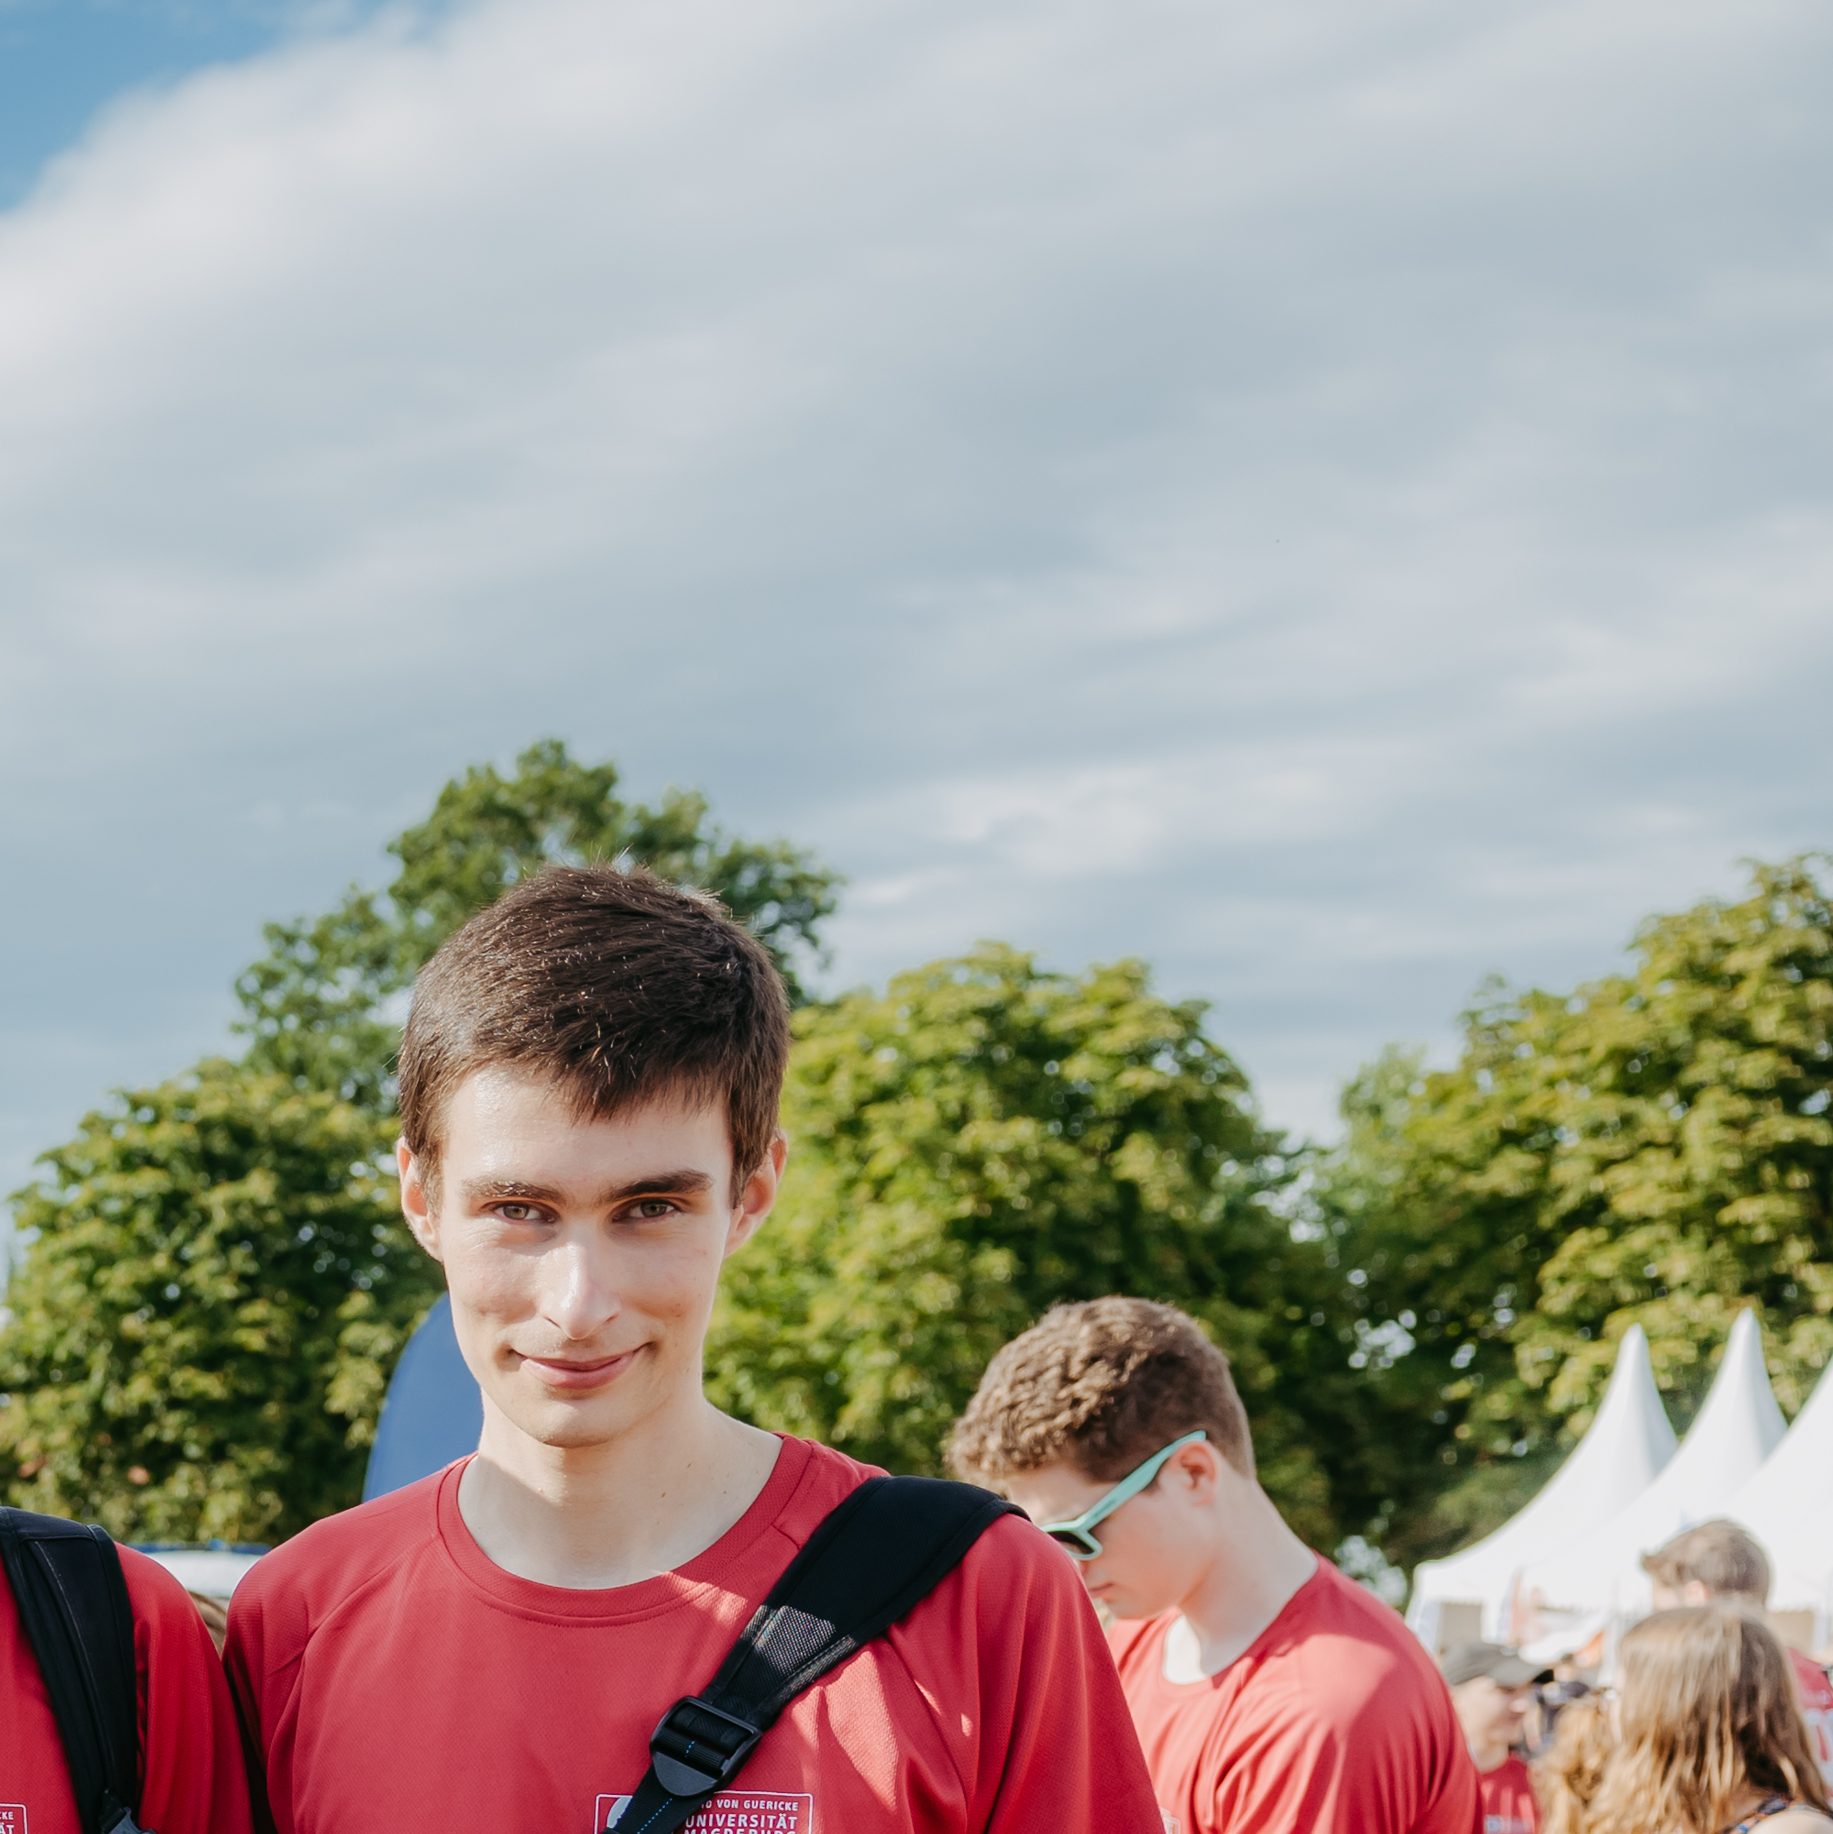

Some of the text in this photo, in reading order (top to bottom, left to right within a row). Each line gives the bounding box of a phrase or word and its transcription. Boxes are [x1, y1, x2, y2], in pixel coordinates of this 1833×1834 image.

[717, 1799, 739, 1809] VON
[743, 1800, 799, 1811] GUERICKE
[685, 1813, 798, 1830] UNIVERSITÄT
